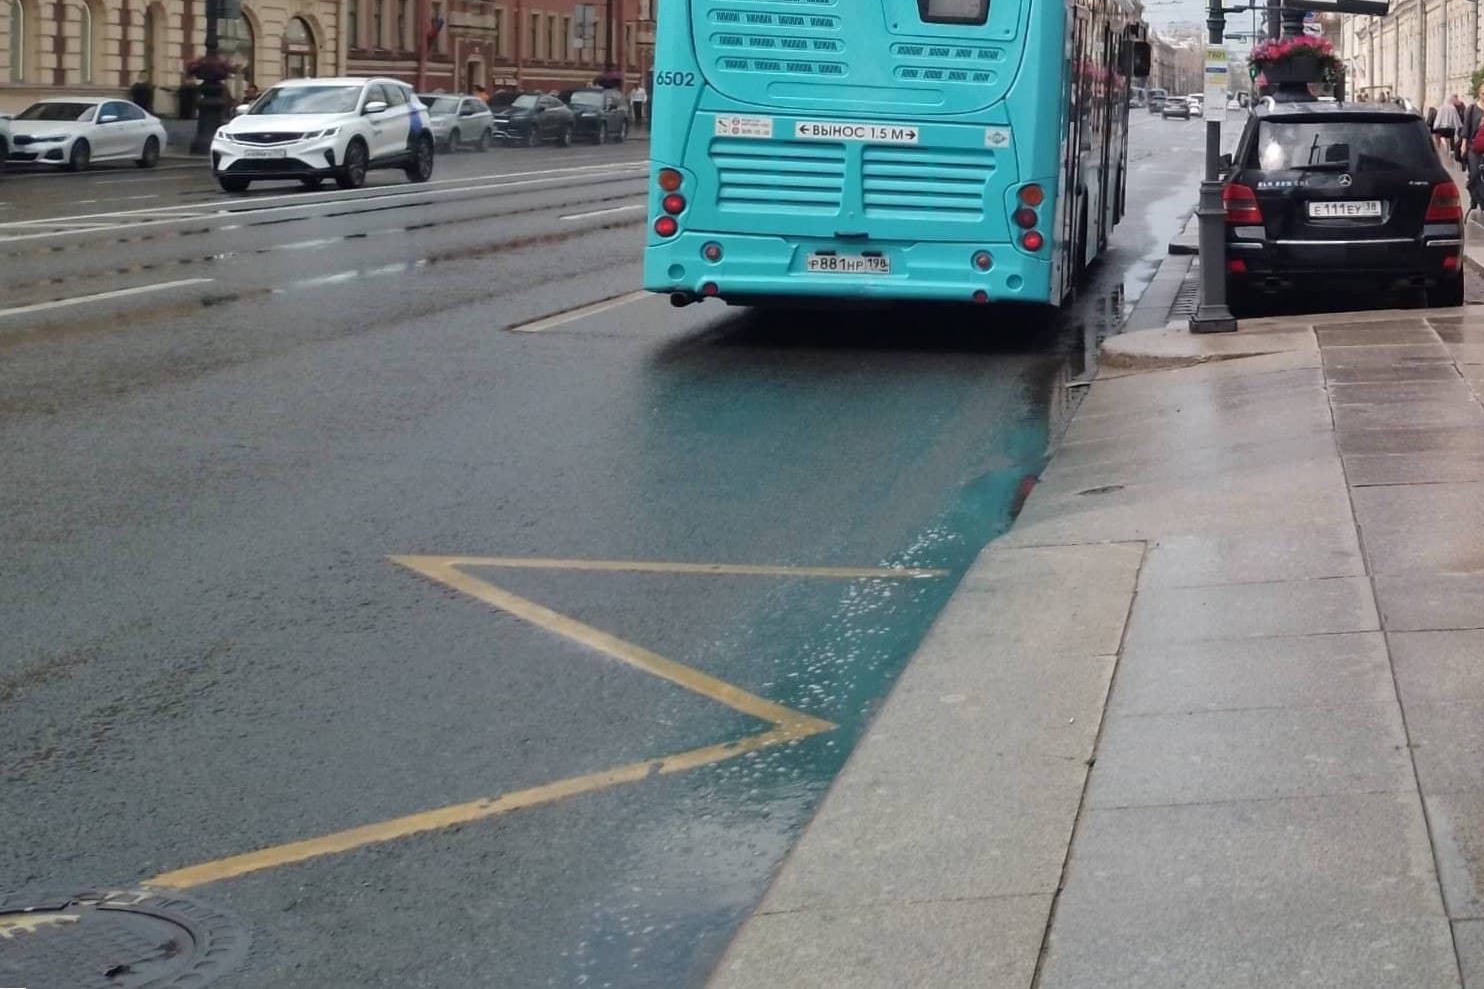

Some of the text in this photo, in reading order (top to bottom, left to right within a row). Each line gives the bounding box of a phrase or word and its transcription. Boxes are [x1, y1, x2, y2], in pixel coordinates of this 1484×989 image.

[656, 71, 695, 86] 6502
[813, 125, 865, 139] ВЫНОС
[871, 128, 888, 139] 1.5
